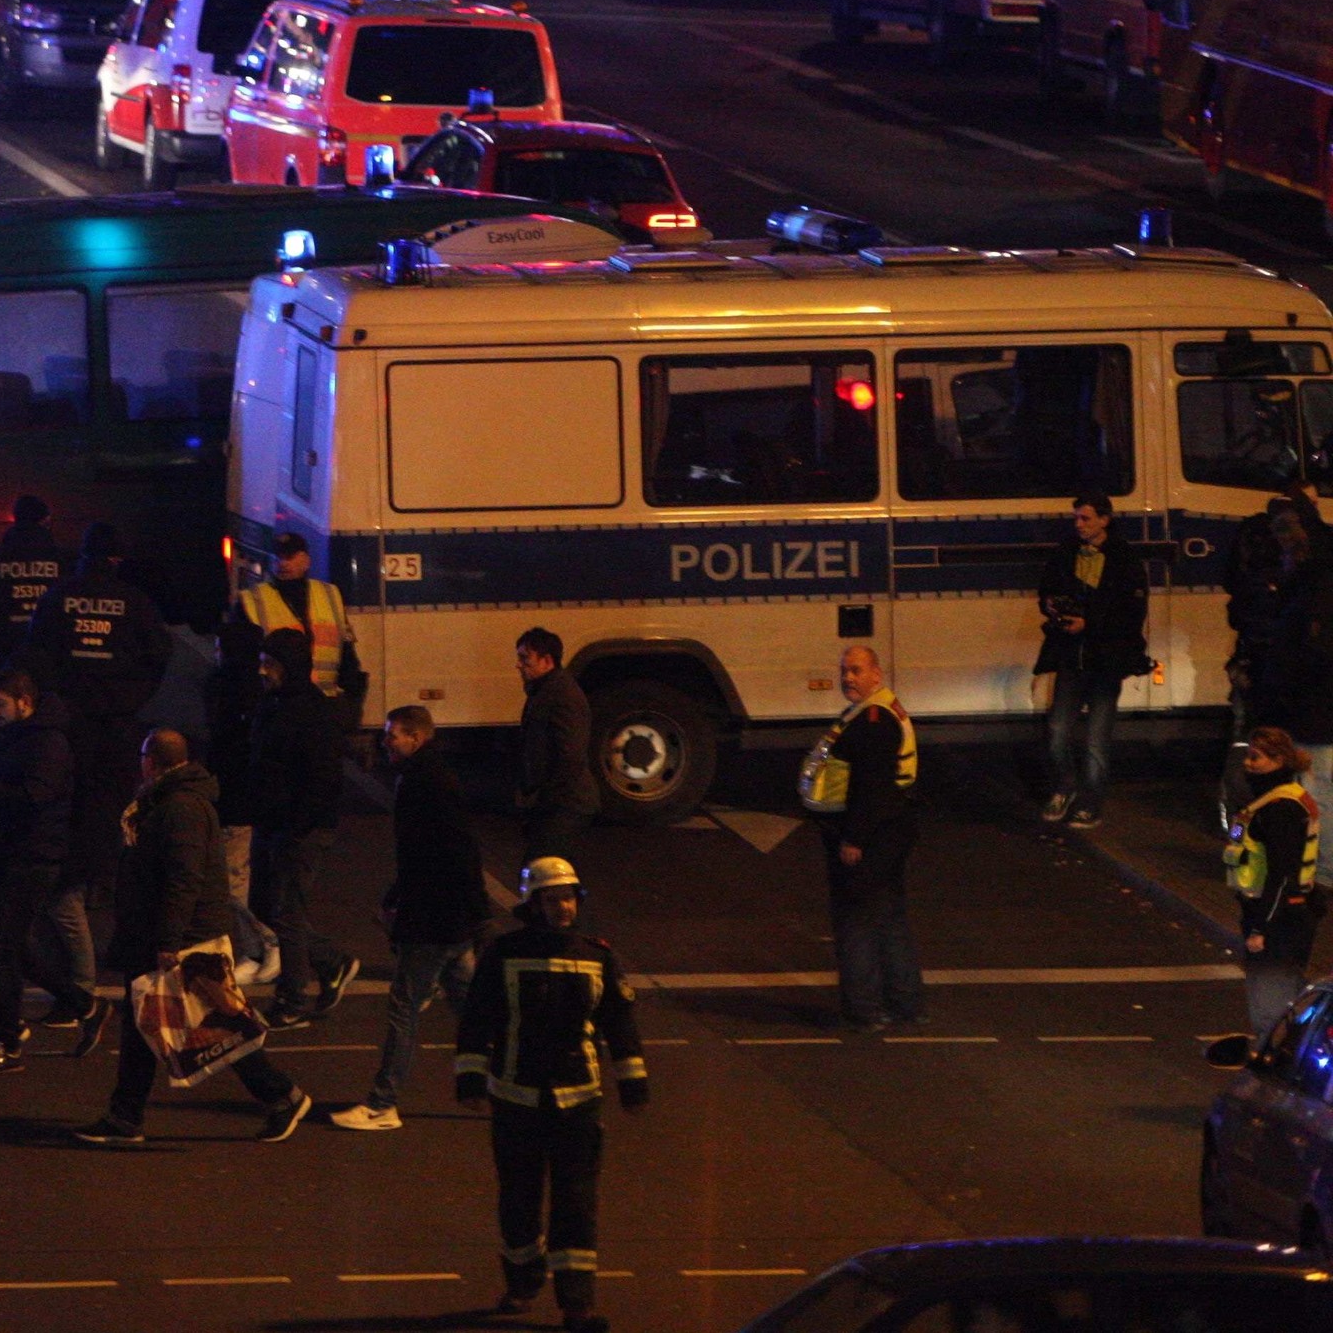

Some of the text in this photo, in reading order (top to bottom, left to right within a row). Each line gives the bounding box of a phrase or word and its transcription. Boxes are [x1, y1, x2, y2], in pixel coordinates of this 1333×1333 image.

[487, 227, 546, 244] EasyCool
[0, 561, 59, 578] POLIZEI
[388, 556, 418, 578] 25
[670, 540, 860, 583] POLIZEI
[64, 597, 125, 616] POLIZEI
